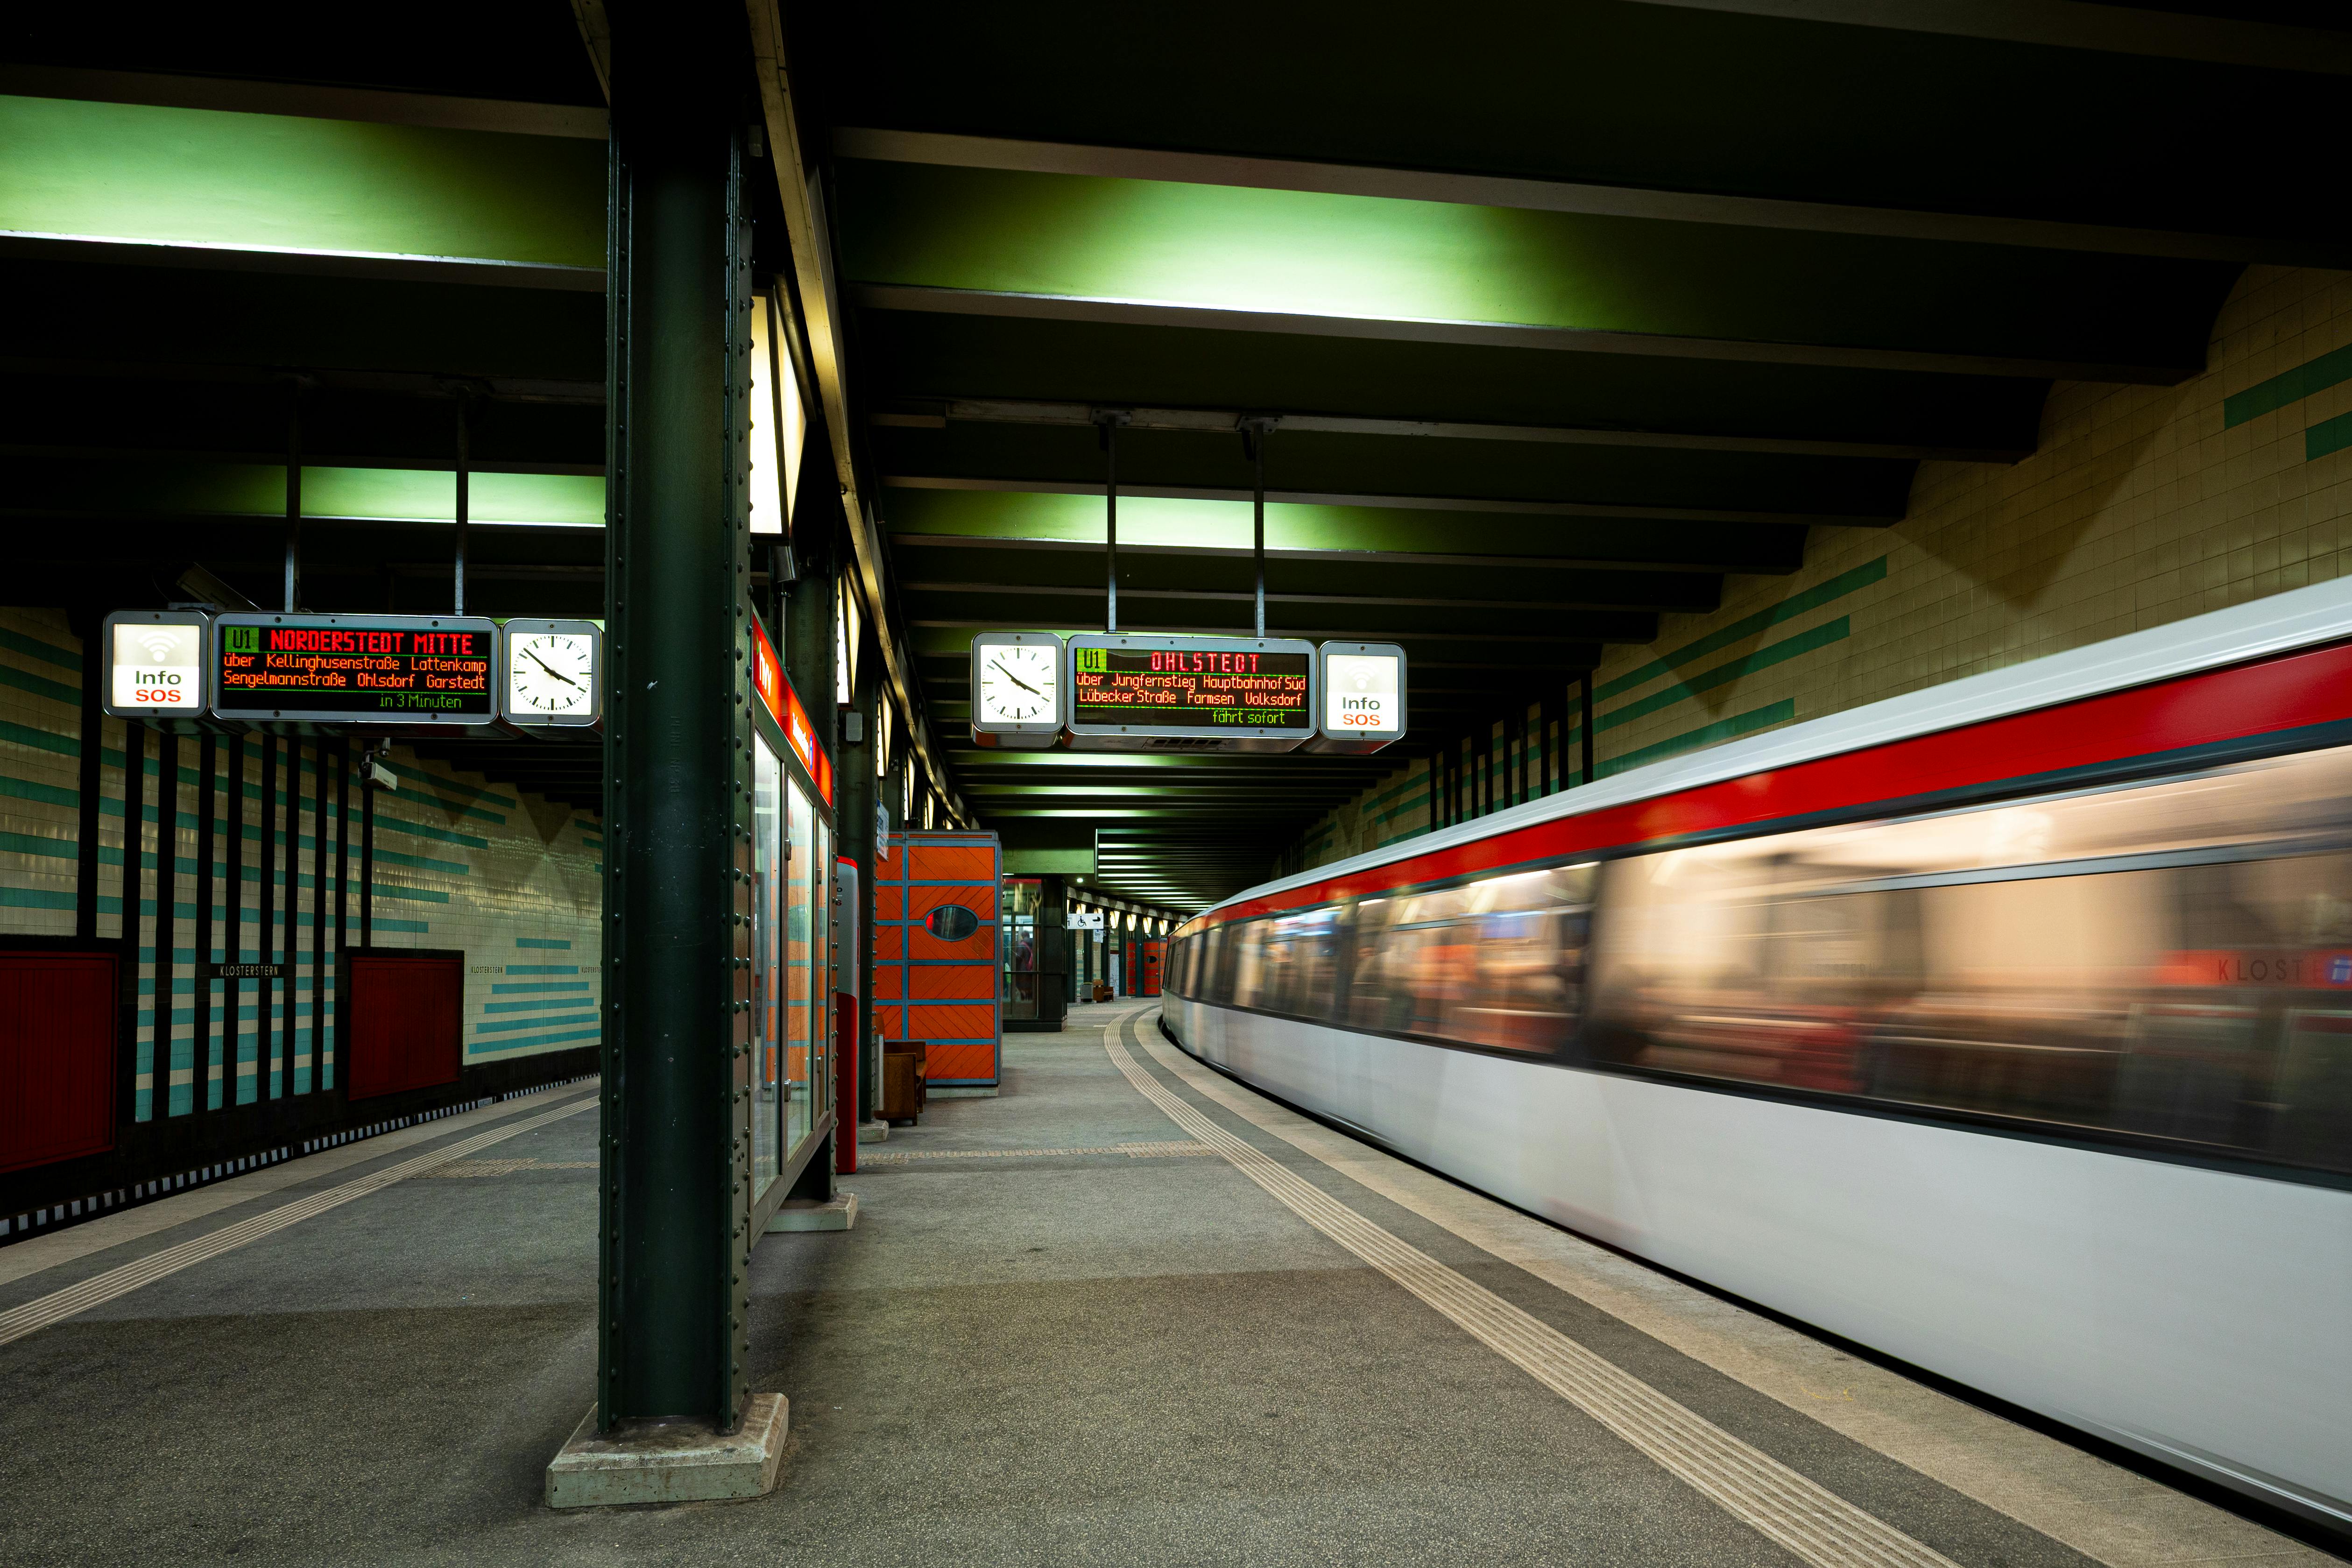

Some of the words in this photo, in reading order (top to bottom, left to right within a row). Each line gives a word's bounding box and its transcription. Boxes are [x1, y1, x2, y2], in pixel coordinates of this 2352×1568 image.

[233, 629, 252, 650] U1
[271, 630, 404, 653] NORDERSTEDT
[414, 634, 473, 655] MITTE
[224, 653, 254, 668] über
[267, 654, 400, 671] Kellinghusenstraße
[411, 657, 487, 674] Lattenkamp
[1084, 650, 1101, 669] U1
[1151, 652, 1260, 674] OHLSTEDT
[136, 671, 182, 685] Info
[224, 671, 346, 688] Sengelmannstraße
[358, 673, 416, 688] Ohlsdorf
[427, 674, 485, 689] Garstedt
[1077, 672, 1103, 686] über
[1111, 673, 1196, 691] Jungfernstieg
[1203, 676, 1283, 691] Hauptbahnhof
[1285, 677, 1306, 691] Süd
[136, 689, 182, 703] SOS
[380, 694, 393, 707] in
[397, 694, 405, 707] 3
[409, 695, 462, 708] Minuten
[1079, 689, 1134, 703] Lübecker
[1137, 690, 1177, 704] Straße
[1187, 692, 1236, 705] Farmsen
[1245, 693, 1303, 707] Volksdorf
[1343, 697, 1381, 711] Info
[1213, 710, 1243, 724] fährt
[1248, 711, 1287, 725] sofort
[1343, 714, 1381, 727] SOS
[220, 966, 278, 976] KLOSTERSTERN
